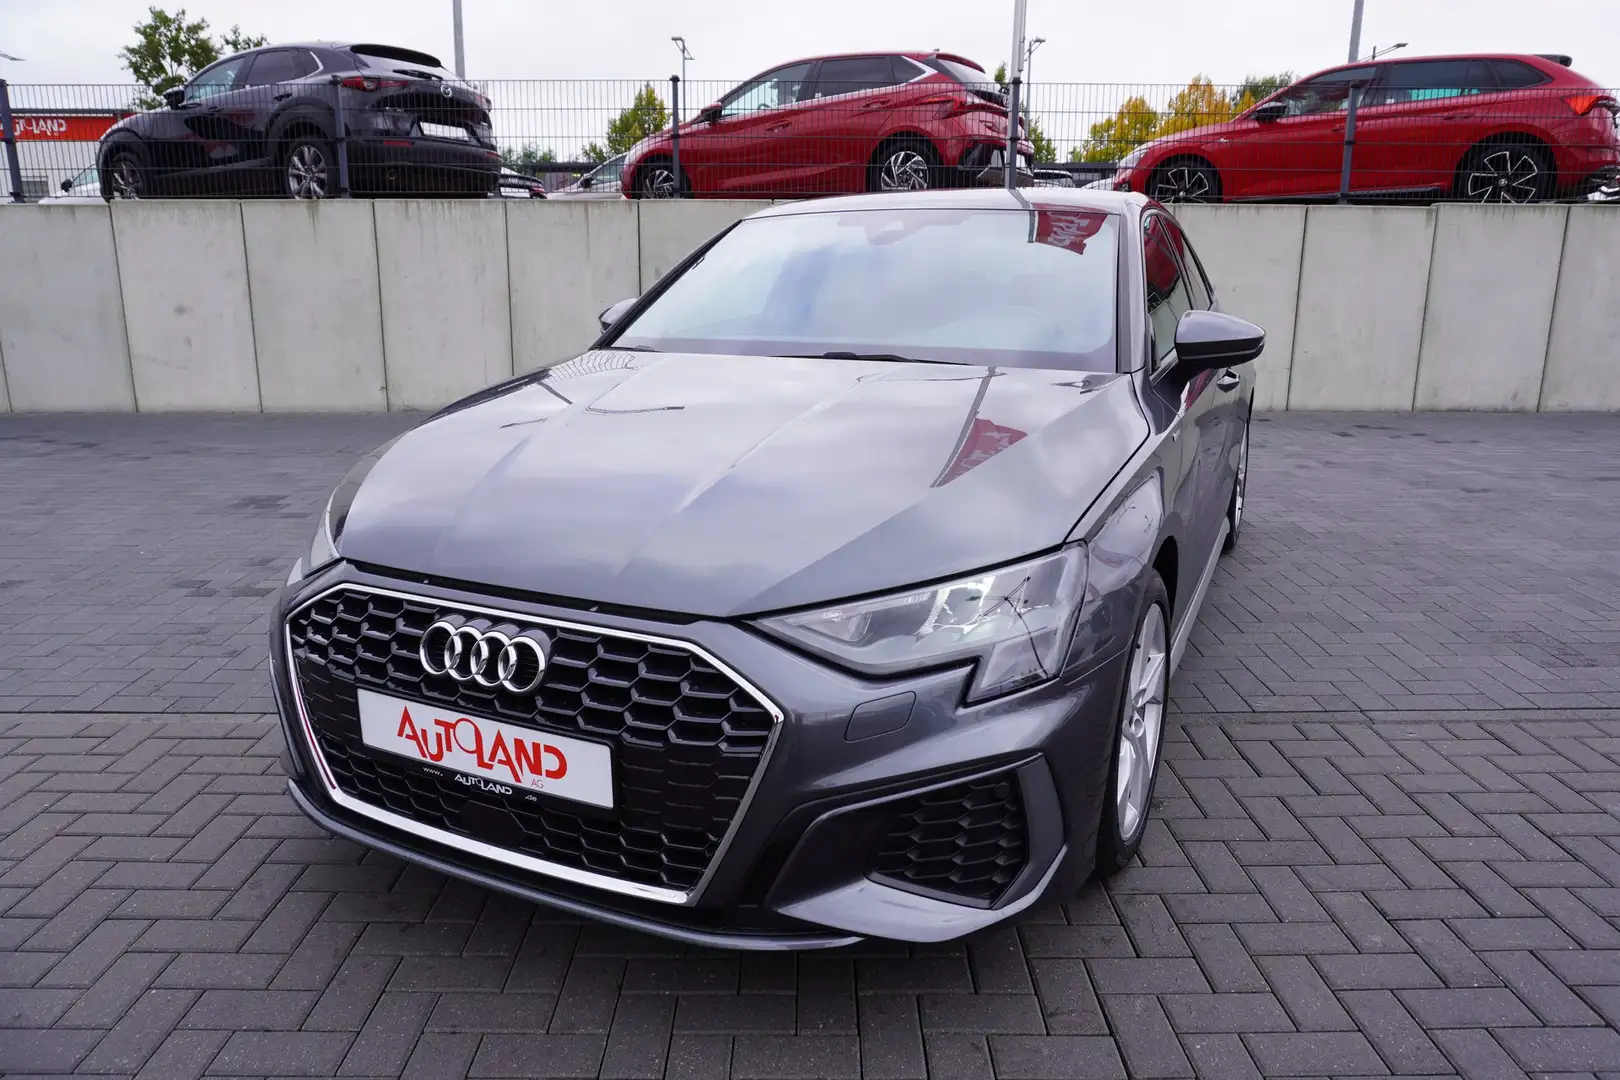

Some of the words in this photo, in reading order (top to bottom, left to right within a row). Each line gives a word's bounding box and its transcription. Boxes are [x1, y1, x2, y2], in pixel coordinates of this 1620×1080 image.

[397, 705, 567, 783] AUTOLAND
[454, 774, 513, 795] AUTOLAND
[531, 779, 543, 789] AG
